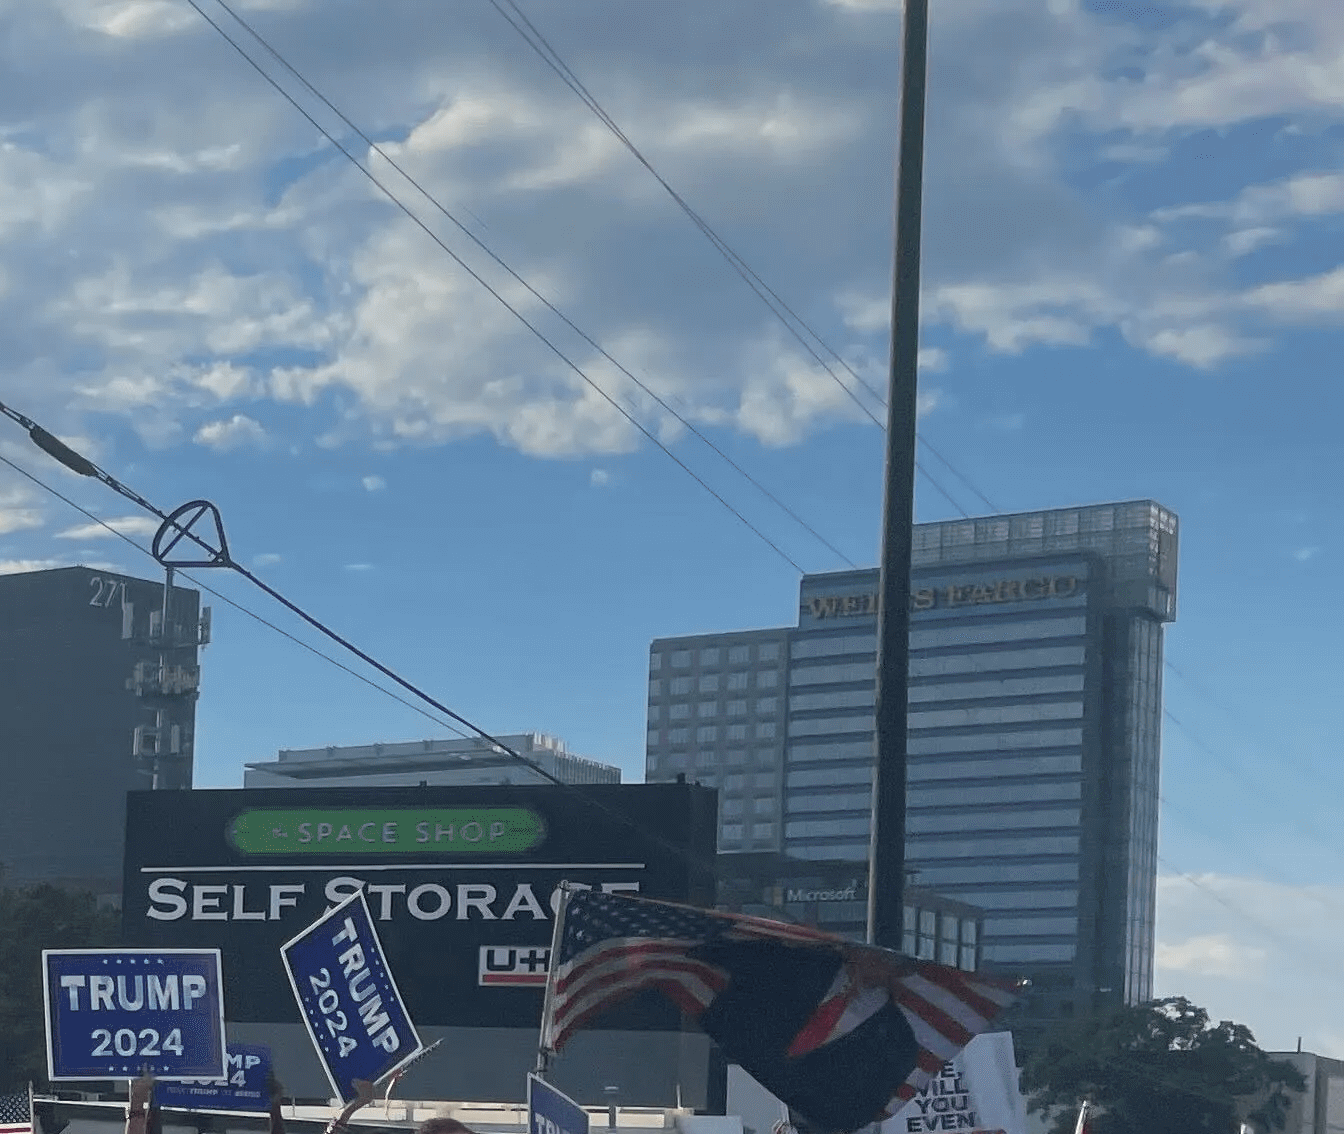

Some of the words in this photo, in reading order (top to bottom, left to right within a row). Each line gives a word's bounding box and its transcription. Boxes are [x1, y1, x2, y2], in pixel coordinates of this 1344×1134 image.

[89, 577, 127, 609] 271
[807, 586, 934, 619] WELS
[947, 575, 1077, 606] FARGO
[297, 822, 398, 843] SPACE
[415, 822, 505, 843] SHOP
[147, 877, 304, 921] SELF
[60, 974, 207, 1012] TRUMP
[331, 916, 401, 1053] TRUMP
[309, 967, 358, 1058] 2024
[91, 1028, 184, 1057] 2024
[905, 1112, 976, 1133] EVEN
[914, 1097, 969, 1115] YOU
